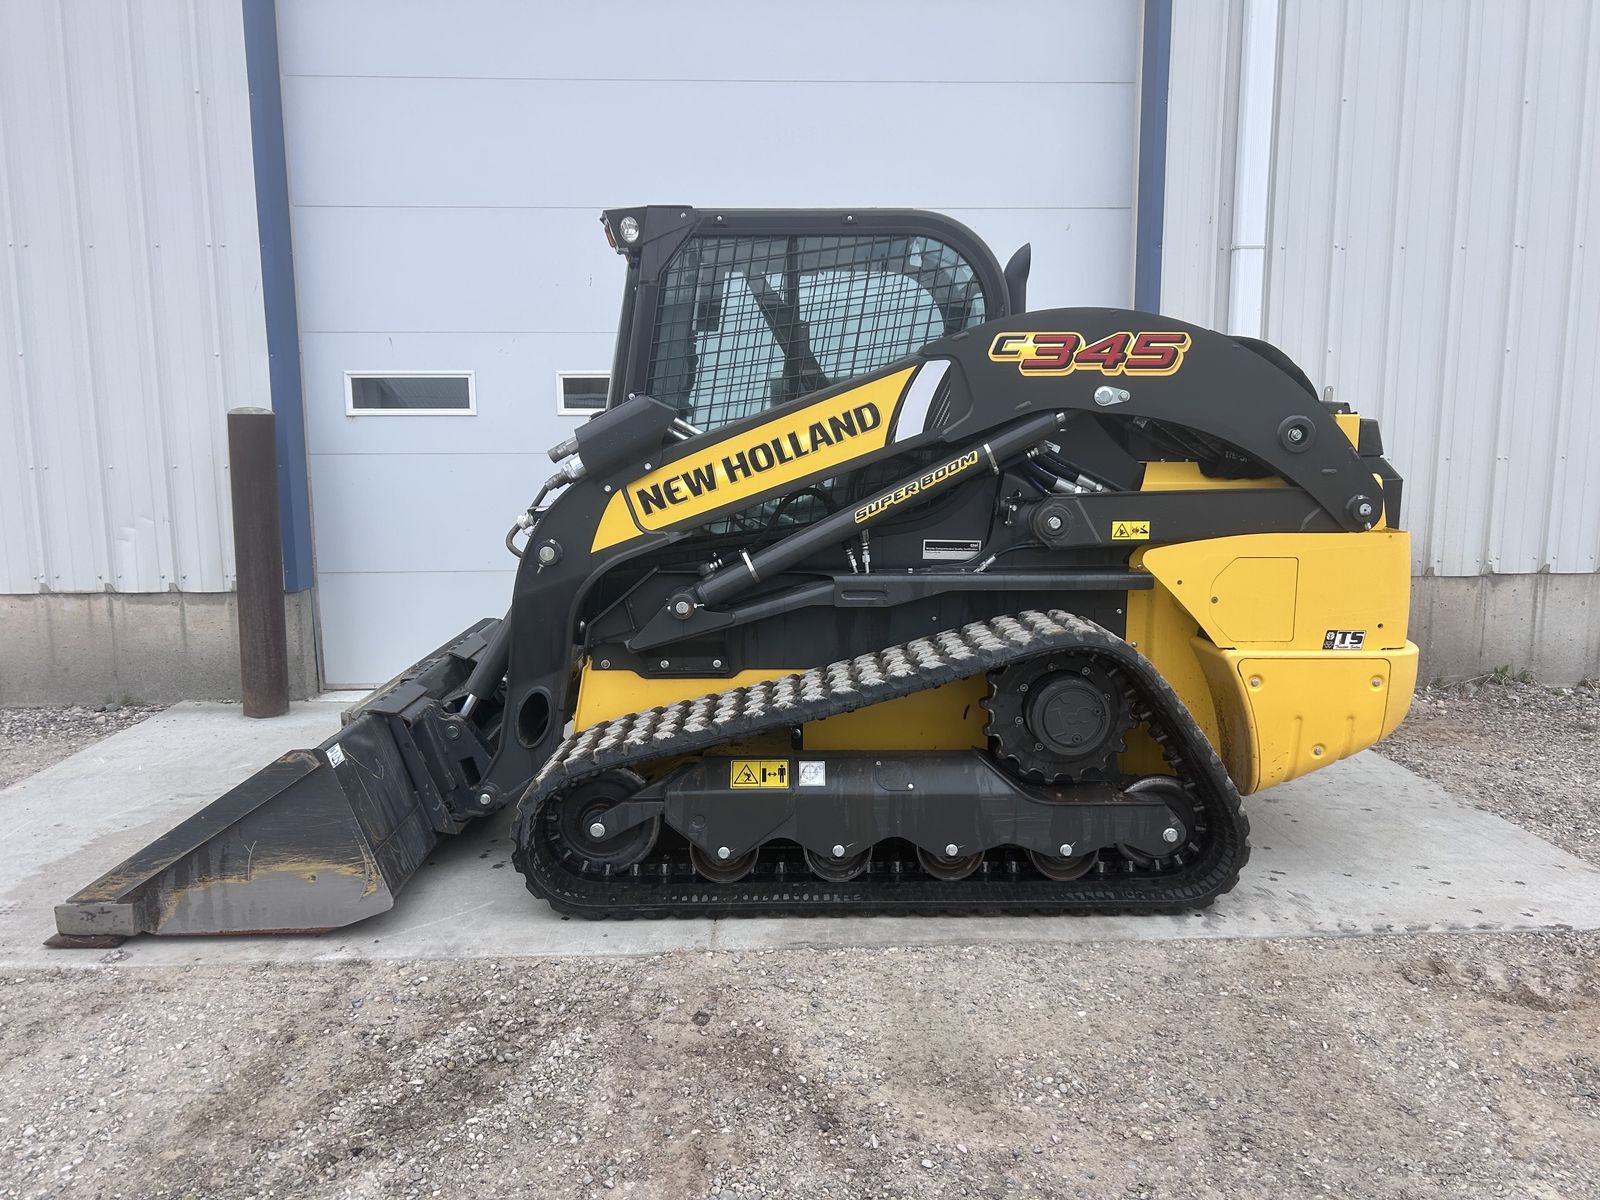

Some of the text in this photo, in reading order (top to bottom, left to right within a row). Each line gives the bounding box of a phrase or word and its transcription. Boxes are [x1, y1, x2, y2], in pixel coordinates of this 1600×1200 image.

[989, 331, 1191, 375] C345
[636, 402, 881, 515] NEW HOLLAND
[855, 450, 978, 523] SUPER BOOM
[1338, 632, 1364, 645] TS
